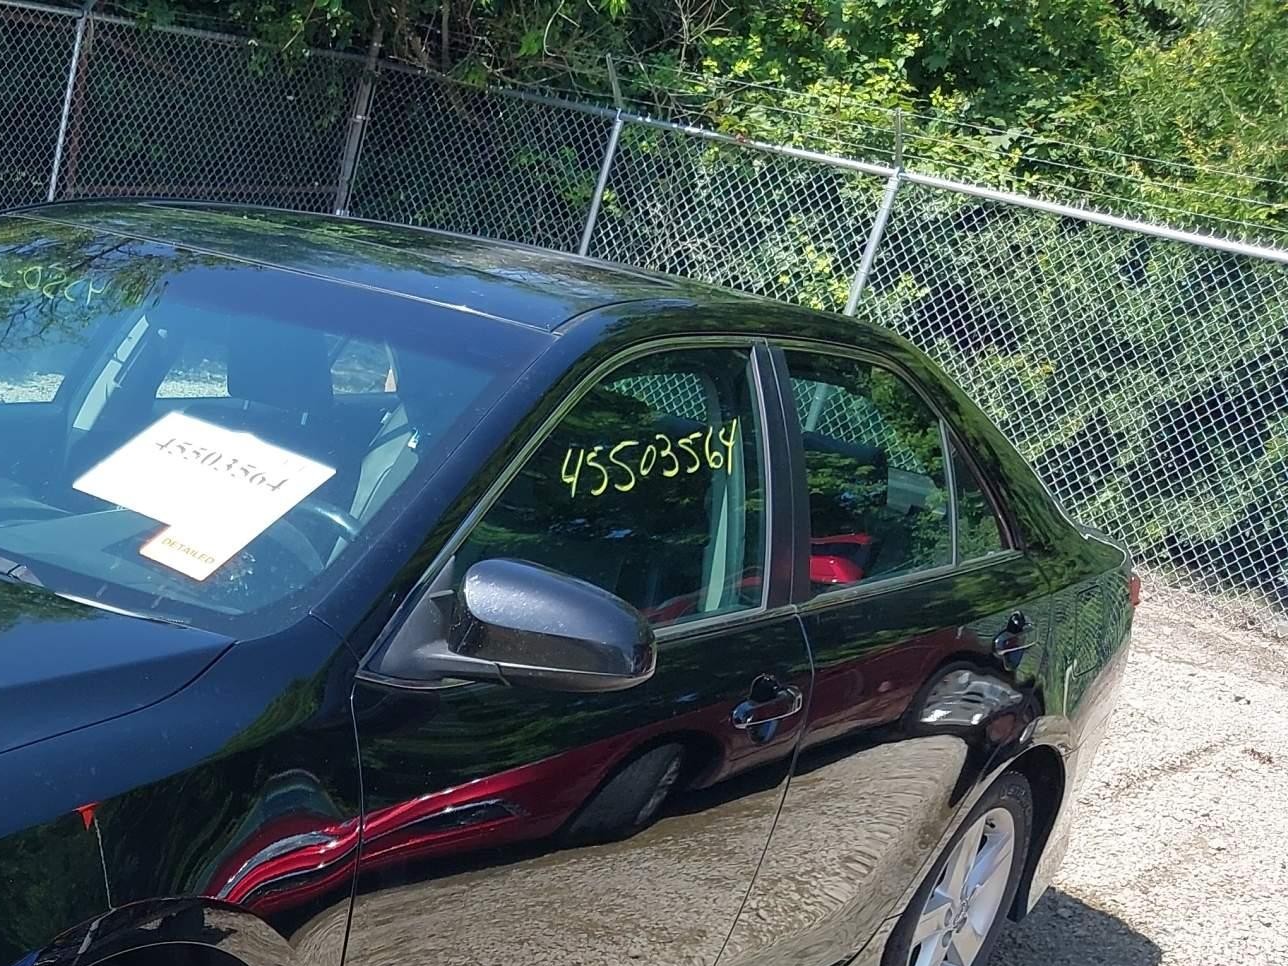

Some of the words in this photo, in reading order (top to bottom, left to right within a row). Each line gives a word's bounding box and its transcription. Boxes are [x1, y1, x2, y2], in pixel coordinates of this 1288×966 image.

[155, 438, 289, 492] 45503564
[561, 418, 737, 498] 45503564
[161, 537, 216, 565] DETAILED
